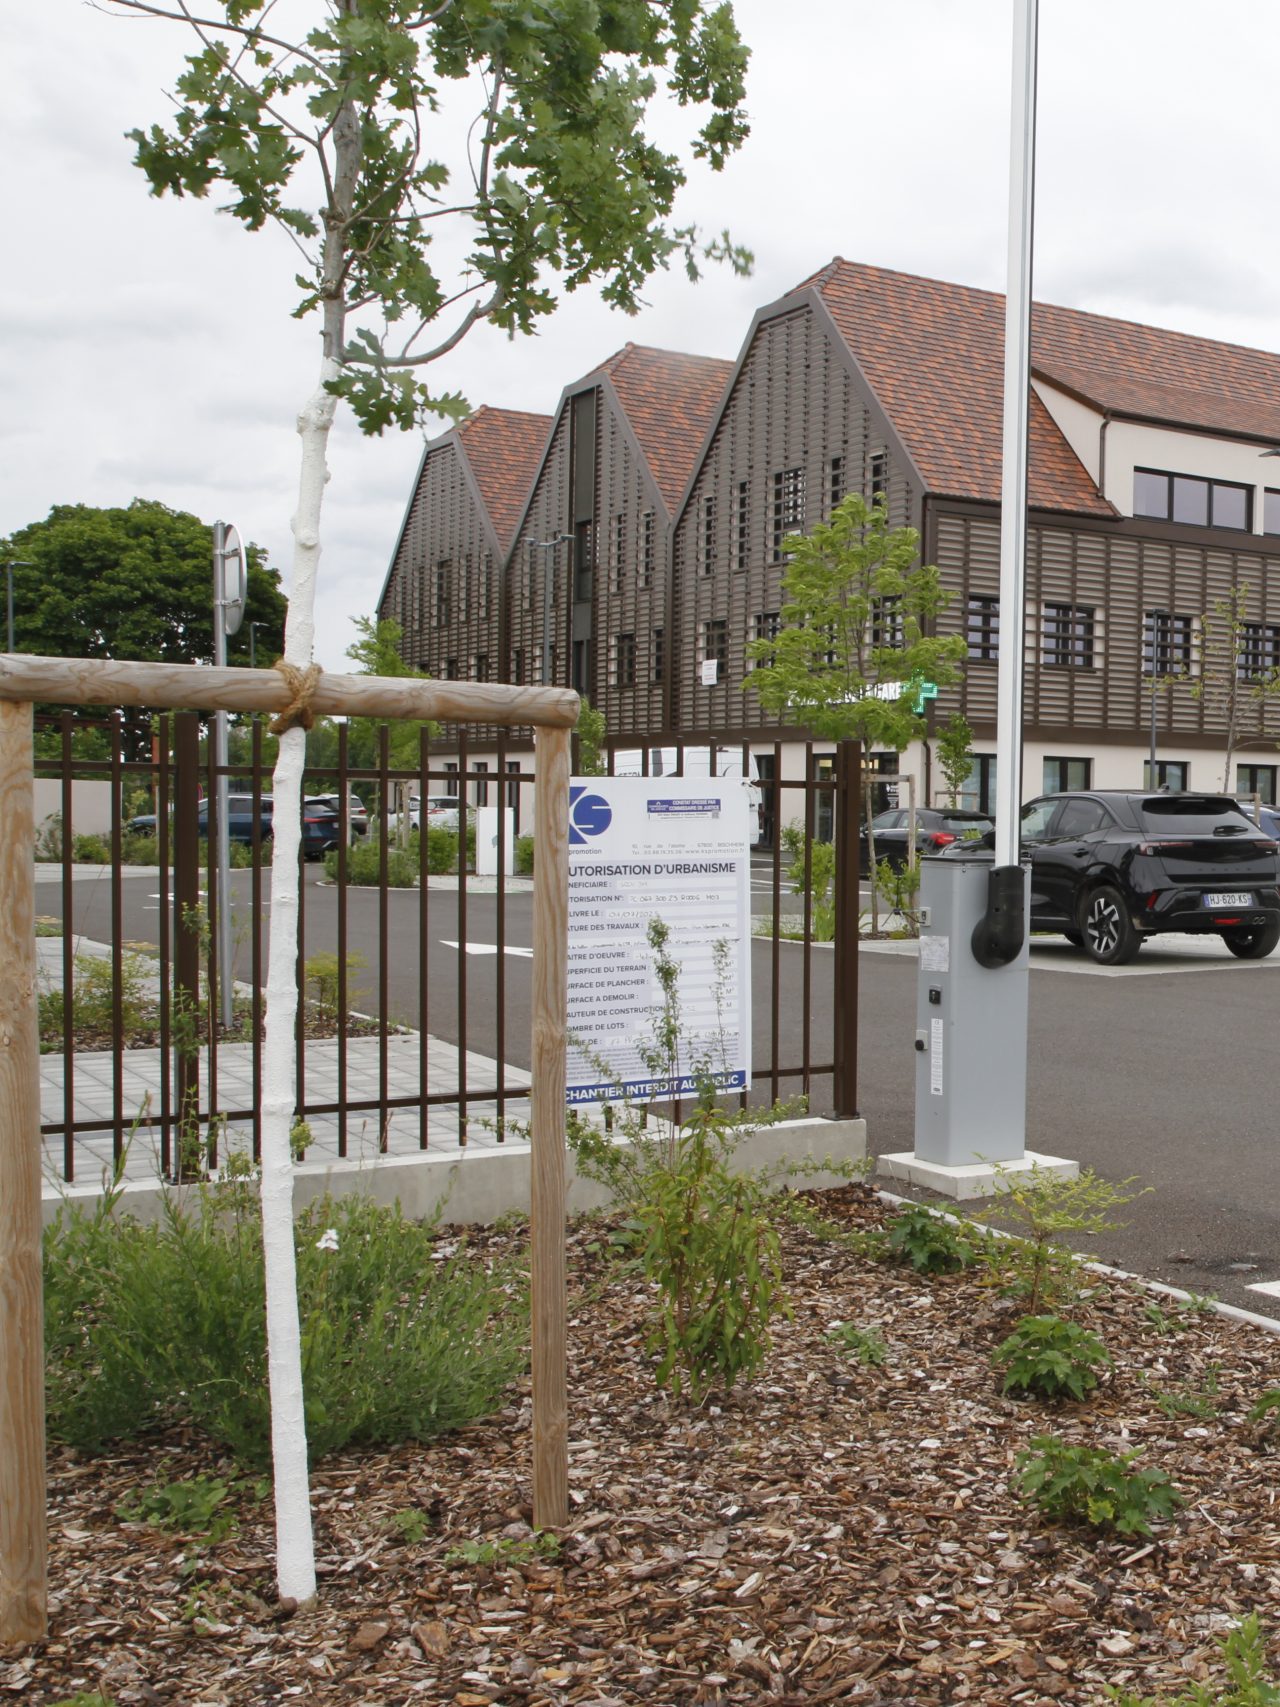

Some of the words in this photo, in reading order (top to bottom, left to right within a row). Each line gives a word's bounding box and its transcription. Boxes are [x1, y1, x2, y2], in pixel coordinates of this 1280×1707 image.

[568, 865, 651, 877] UTORISATION
[654, 862, 737, 875] D'URBANISME
[568, 881, 609, 889] NEFICIAIRE
[569, 910, 589, 918] LIVRE
[606, 922, 640, 930] TRAVAUX
[567, 953, 587, 961] AITRE
[589, 951, 626, 960] D'OEUVRE
[567, 967, 602, 975] PERFICIE
[616, 964, 647, 973] TERRAIN
[607, 978, 646, 987] PLANCHER
[567, 996, 594, 1004] URFACE
[602, 993, 635, 1002] DEMOLIR
[566, 1010, 596, 1018] AUTEUR
[597, 1009, 608, 1017] DE
[595, 1023, 605, 1031] DE
[606, 1022, 625, 1030] LOTS
[566, 1085, 624, 1101] CHANTIER
[626, 1080, 679, 1096] INTERDIT
[680, 1077, 697, 1090] AU
